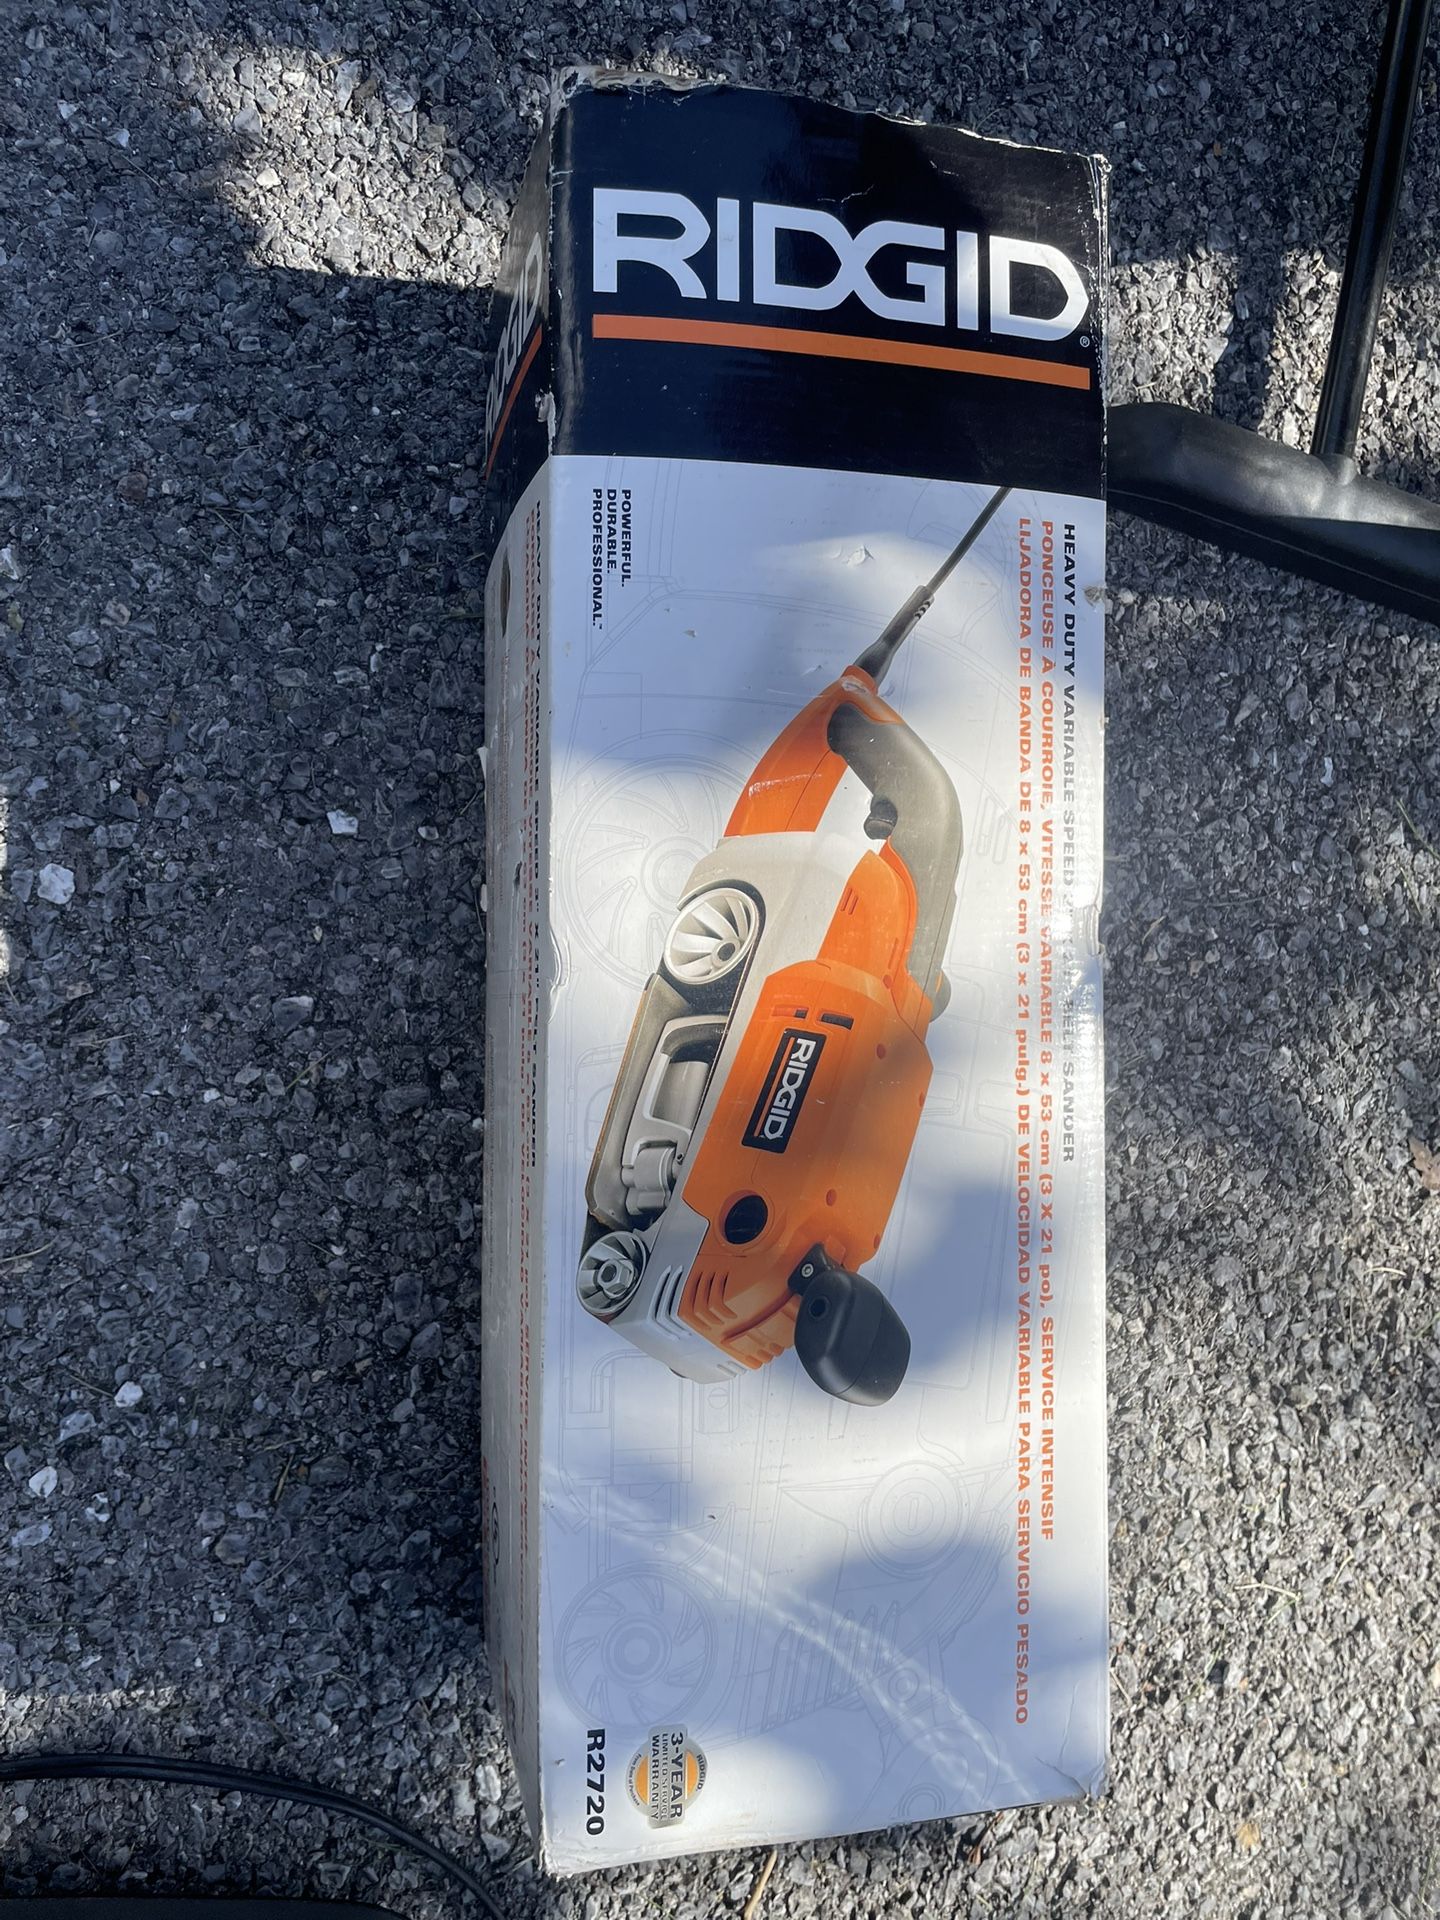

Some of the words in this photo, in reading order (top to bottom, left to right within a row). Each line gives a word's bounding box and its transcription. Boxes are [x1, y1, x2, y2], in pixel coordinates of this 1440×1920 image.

[607, 488, 617, 574] DURABLE.
[621, 489, 632, 587] POWERFUL.
[1064, 524, 1075, 606] HEAVY
[1019, 518, 1031, 639] LIJADORA
[1042, 521, 1054, 648] PONCEUSE
[1019, 647, 1031, 678] DE
[1042, 656, 1056, 673] À
[1064, 613, 1075, 677] DUTY
[1019, 686, 1031, 773] BANDA
[1040, 681, 1054, 810] COURROIE,
[1064, 685, 1075, 801] VARIABLE
[1019, 781, 1031, 812] DE
[1019, 819, 1031, 833] 8
[1018, 863, 1031, 891] 53
[1041, 819, 1053, 917] VITESSE
[1064, 810, 1075, 886] SPEED
[1016, 942, 1031, 964] (3
[1018, 898, 1028, 934] cm
[1018, 994, 1031, 1018] 21
[1041, 926, 1053, 1043] VARIABLE
[764, 1038, 817, 1140] RIDGID
[1015, 1029, 1031, 1096] pulg.)
[1041, 1050, 1053, 1064] 8
[1018, 1104, 1031, 1135] DE
[1041, 1094, 1053, 1121] 53
[1041, 1130, 1050, 1165] cm
[1064, 1062, 1075, 1161] SANDER
[1018, 1142, 1031, 1283] VELOCIDAD
[1038, 1173, 1053, 1195] (3
[1041, 1228, 1053, 1253] 21
[1039, 1264, 1053, 1308] po),
[1018, 1291, 1031, 1414] VARIABLE
[1041, 1317, 1054, 1421] SERVICE
[1018, 1422, 1031, 1490] PARA
[1041, 1428, 1054, 1540] INTENSIF
[1017, 1499, 1030, 1615] SERVICIO
[1016, 1623, 1029, 1724] PESADO
[586, 1728, 606, 1836] R2720
[650, 1735, 660, 1820] WARRANTY
[661, 1733, 669, 1775] LIMITED
[670, 1732, 684, 1818] 3-YEAR
